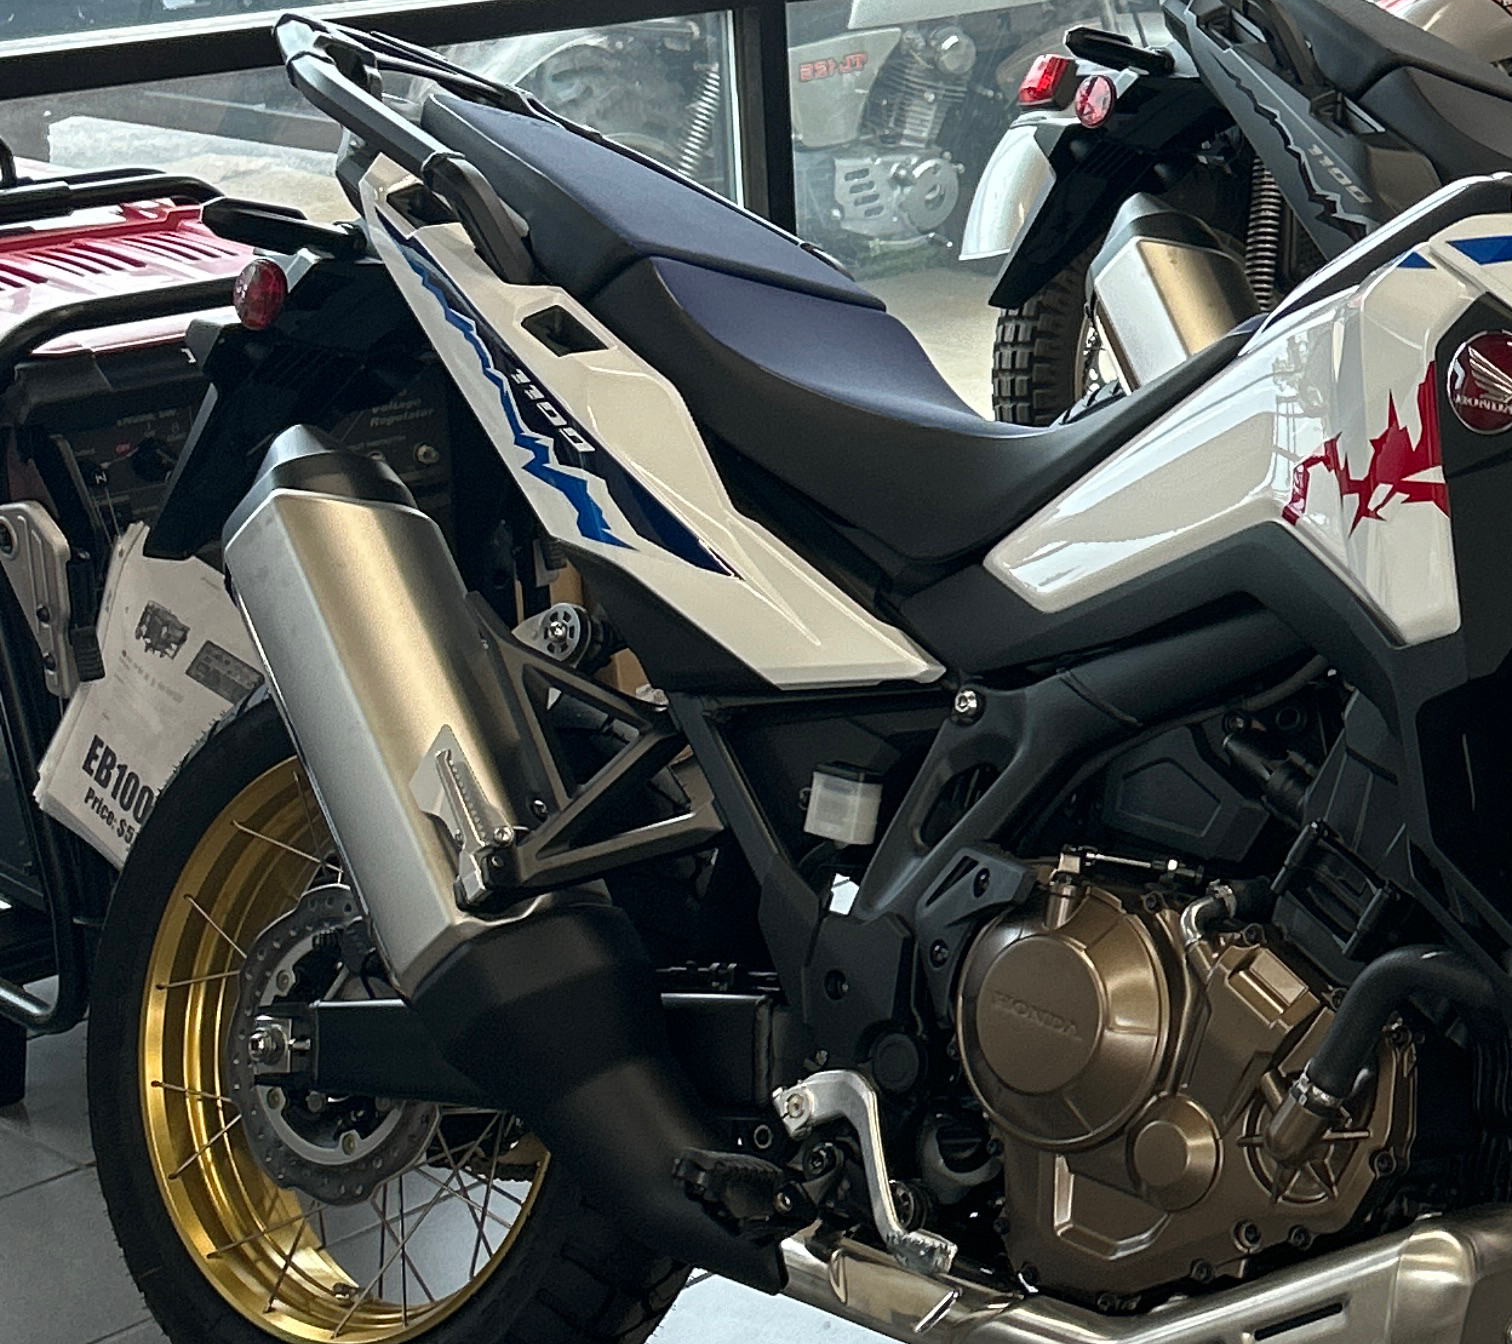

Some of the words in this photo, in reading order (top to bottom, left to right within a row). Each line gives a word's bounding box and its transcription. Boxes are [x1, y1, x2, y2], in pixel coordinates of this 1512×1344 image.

[1308, 143, 1373, 203] 1100
[511, 368, 596, 453] 1100
[84, 787, 117, 829] Price:
[991, 991, 1083, 1041] HONDA
